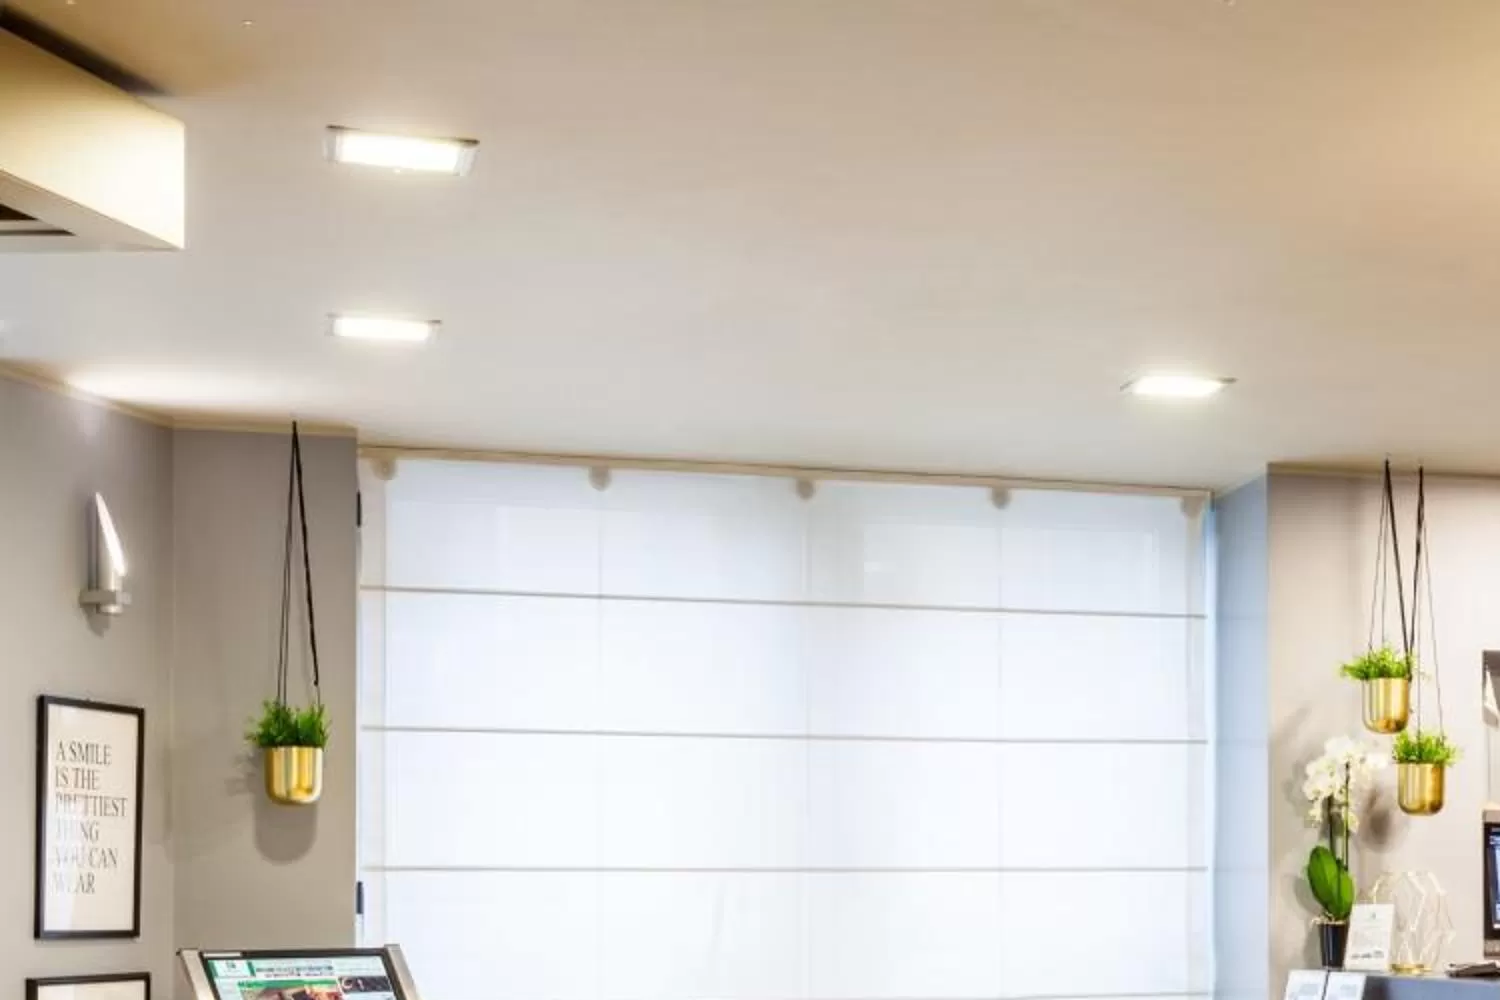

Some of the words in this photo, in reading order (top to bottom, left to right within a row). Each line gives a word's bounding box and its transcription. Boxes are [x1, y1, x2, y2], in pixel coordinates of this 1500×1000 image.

[56, 740, 66, 761] A
[68, 741, 112, 766] SMILE
[55, 766, 69, 789] IS
[71, 767, 101, 790] THE
[87, 847, 118, 869] CAN
[53, 870, 96, 894] WAR
